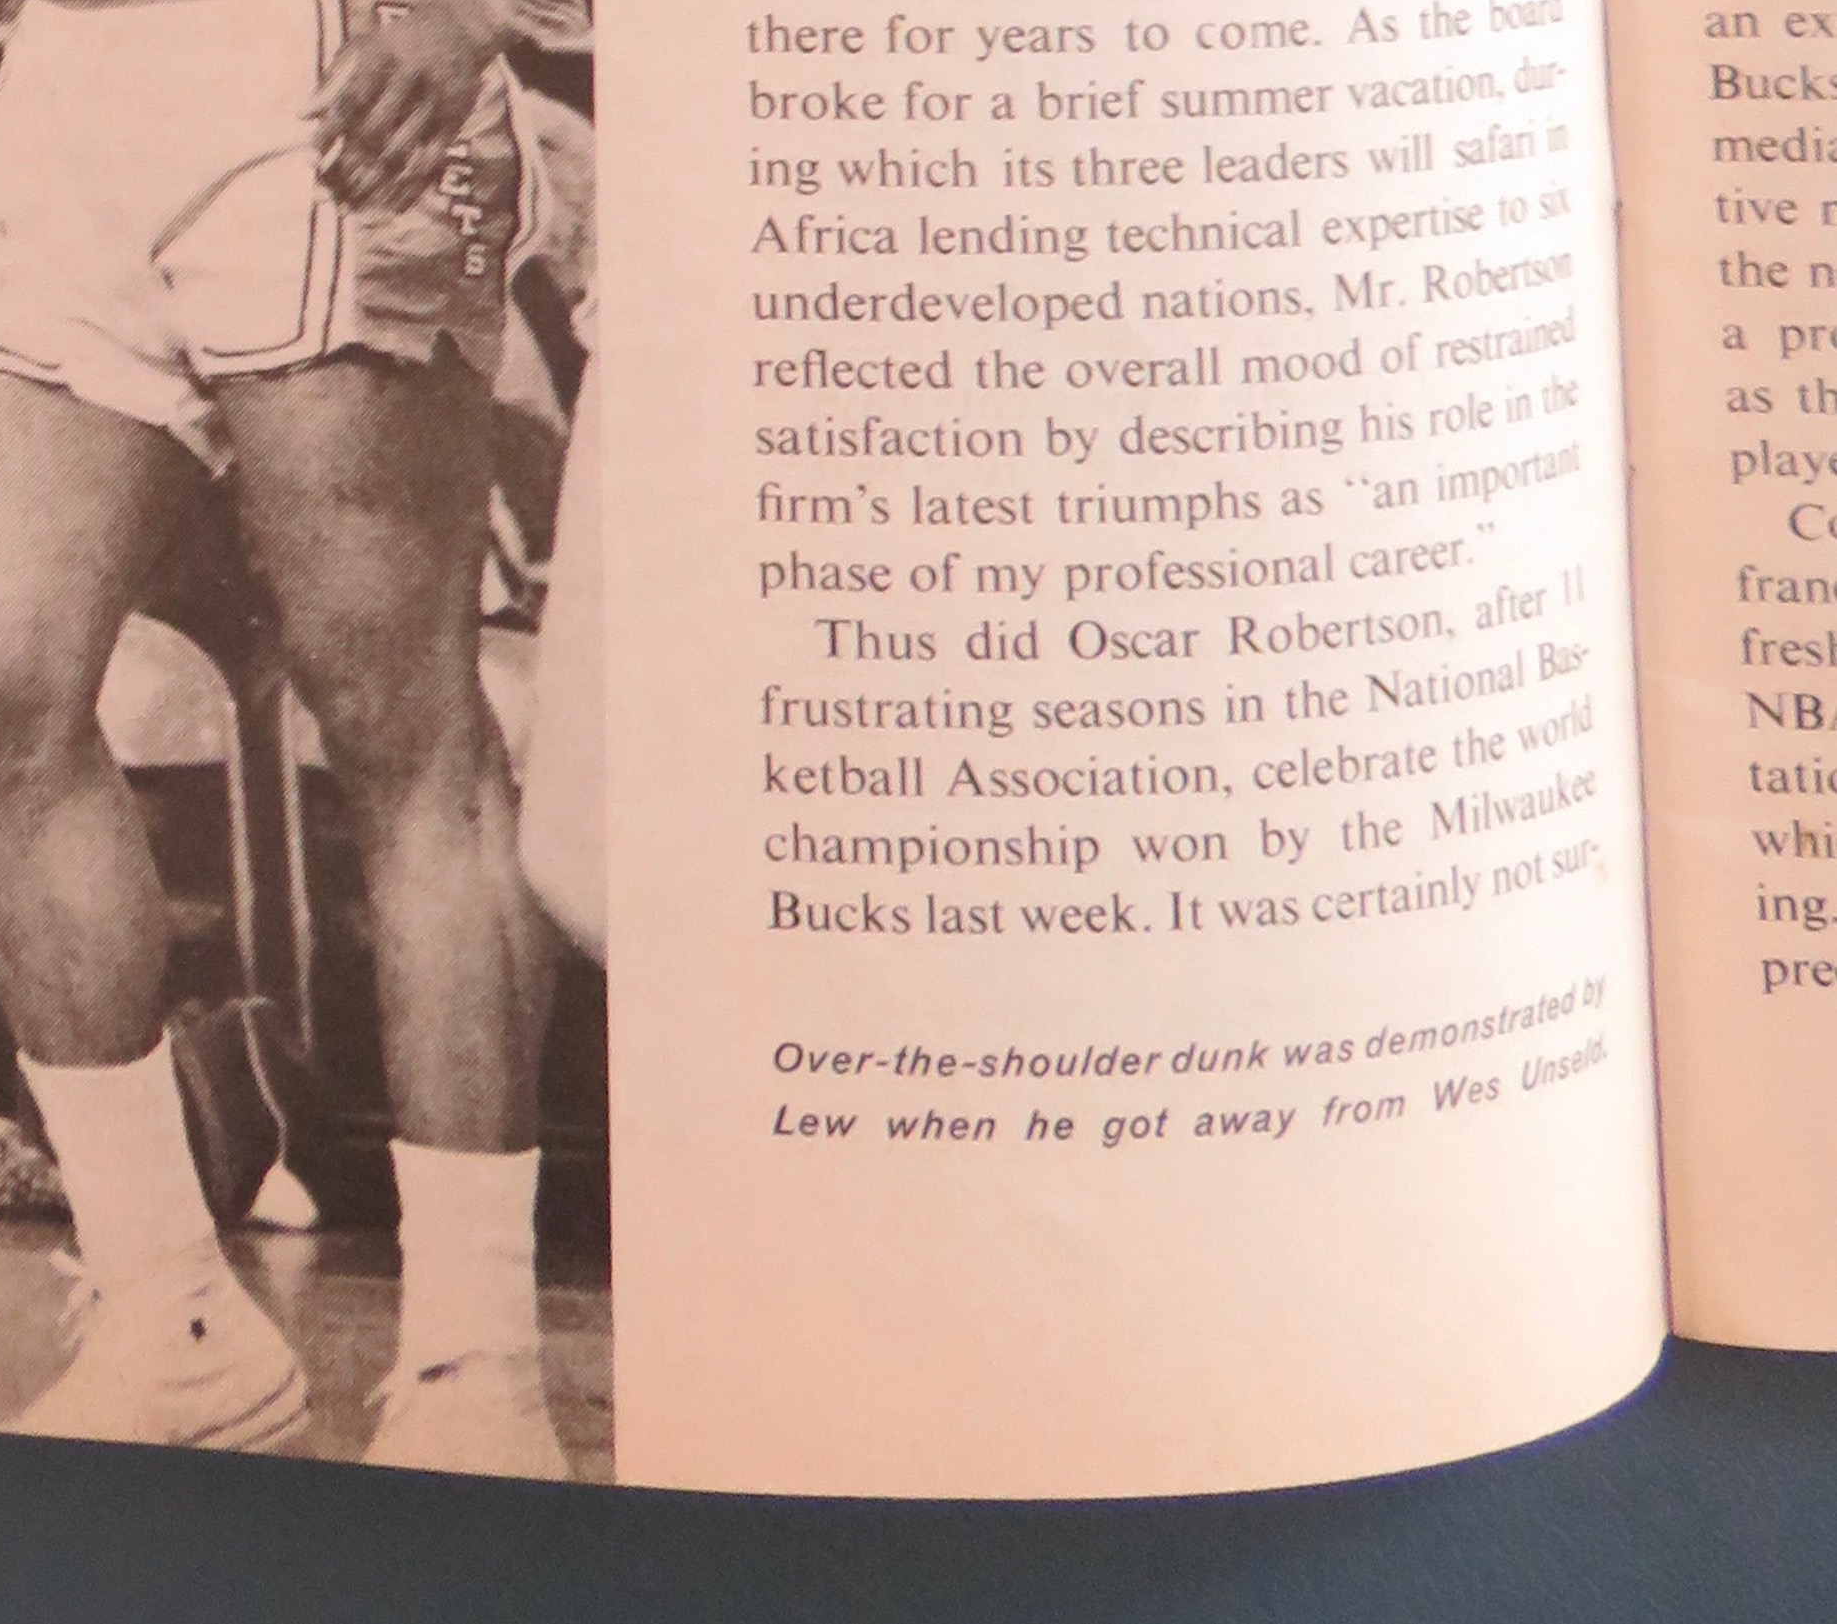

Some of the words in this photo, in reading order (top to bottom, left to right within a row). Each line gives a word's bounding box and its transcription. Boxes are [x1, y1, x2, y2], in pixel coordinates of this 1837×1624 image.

[1705, 11, 1759, 39] an
[751, 213, 899, 256] Africa
[919, 214, 1089, 263] lending
[1106, 208, 1301, 255] technical
[1321, 204, 1484, 252] expertise
[1497, 196, 1528, 227] to
[1715, 187, 1798, 226] tive
[753, 280, 1124, 331] underdeveloped
[1141, 278, 1315, 320] nations,
[1334, 270, 1405, 311] Mr.
[1422, 252, 1571, 304] Robertson
[1718, 250, 1789, 289] the
[1726, 387, 1774, 414] as
[912, 484, 1033, 526] latest
[1057, 480, 1262, 531] triumphs
[1280, 488, 1325, 517] as
[1436, 443, 1581, 505] important
[815, 618, 937, 661] Thus
[965, 619, 1040, 661] did
[1068, 620, 1200, 660] Oscar
[1475, 583, 1547, 631] after
[764, 821, 1101, 875] championship
[1132, 832, 1228, 863] won
[1260, 817, 1309, 865] by
[1341, 810, 1403, 852] the
[1430, 770, 1596, 841] Milwaukee
[770, 890, 912, 934] Bucks
[926, 893, 1004, 935] last
[1020, 892, 1151, 935] week.
[1171, 891, 1202, 931] It
[1218, 897, 1301, 928] was
[1311, 864, 1478, 924] certainly
[1492, 854, 1545, 897] not
[773, 1041, 1163, 1079] Over-the-shoulder
[1170, 1040, 1269, 1075] dunk
[1283, 1038, 1355, 1067] was
[1364, 985, 1577, 1060] demonstrated
[1581, 977, 1605, 1009] by
[773, 1104, 858, 1137] Lew
[887, 1109, 997, 1141] when
[1025, 1109, 1075, 1141] he
[1101, 1108, 1169, 1150] got
[1193, 1109, 1296, 1140] away
[1322, 1094, 1406, 1127] from
[1433, 1075, 1500, 1112] Wes
